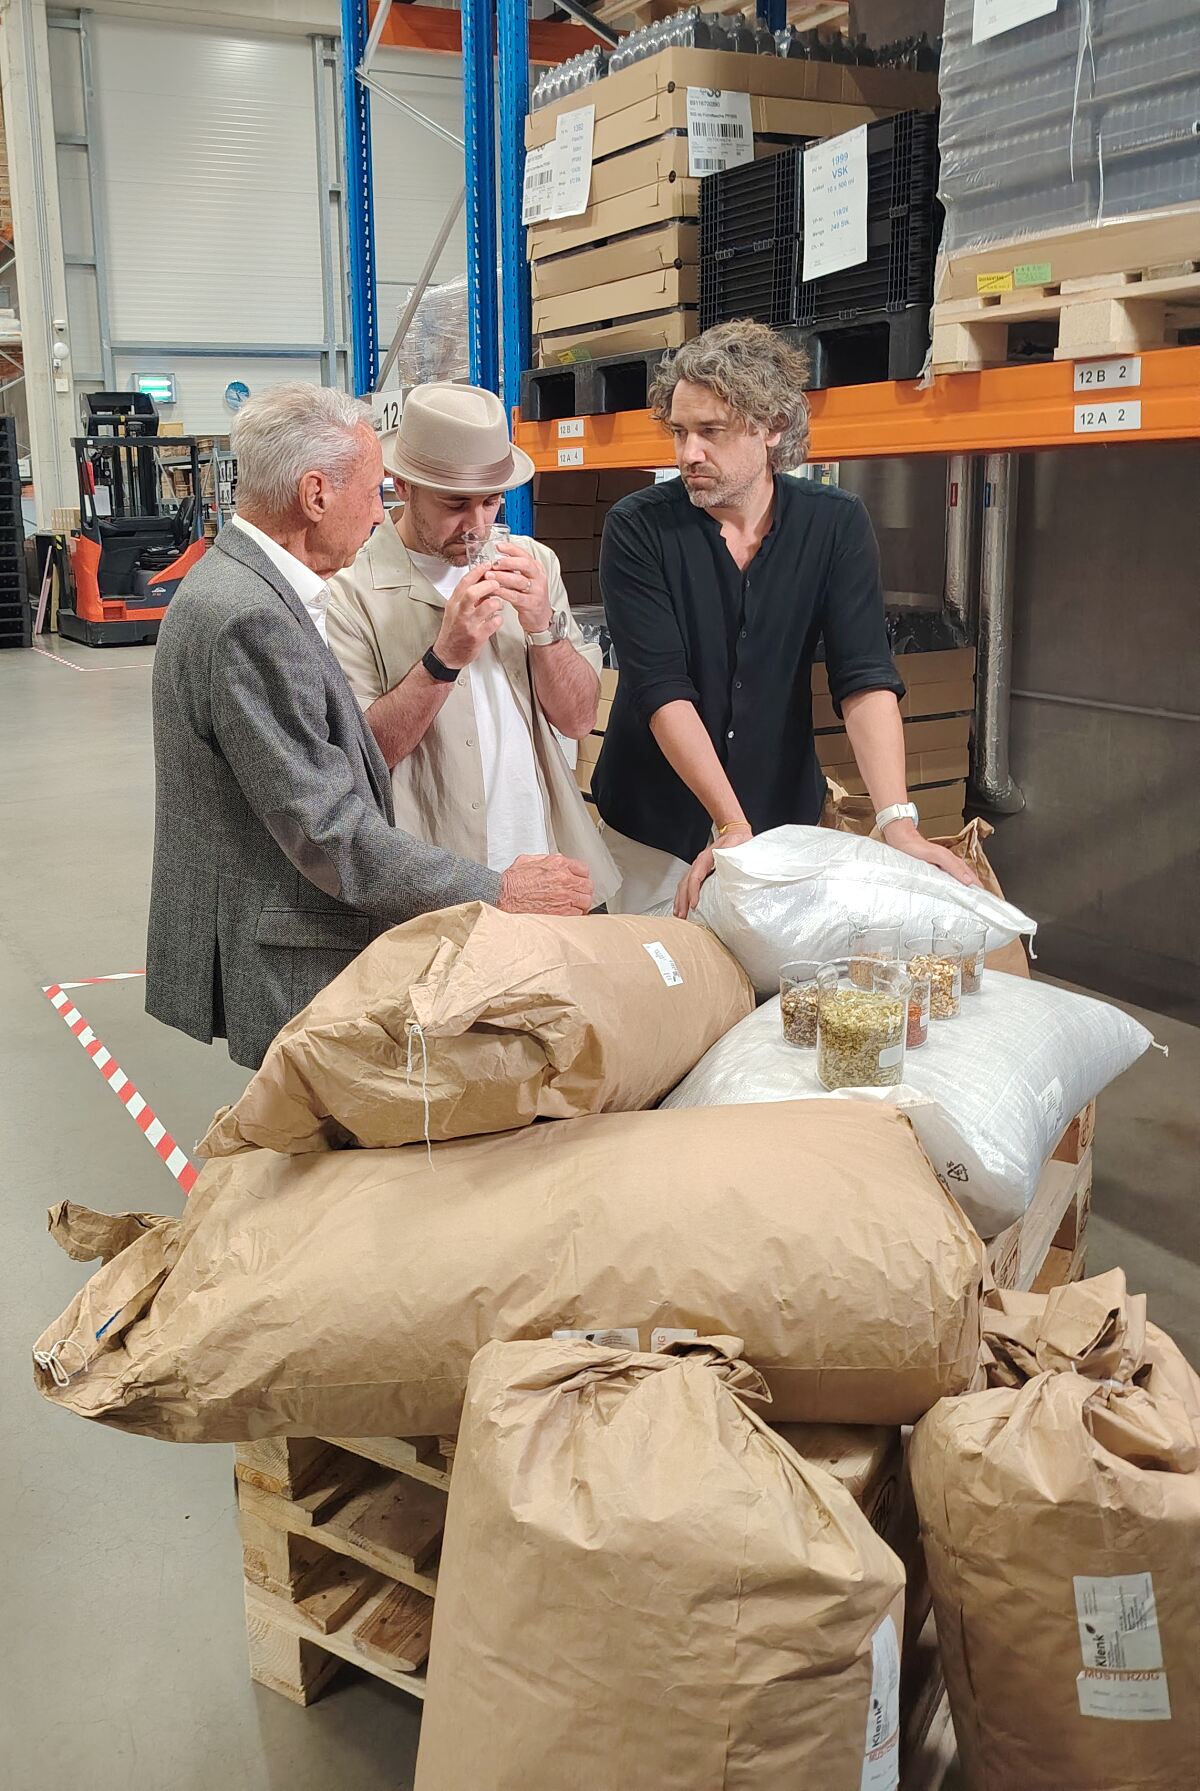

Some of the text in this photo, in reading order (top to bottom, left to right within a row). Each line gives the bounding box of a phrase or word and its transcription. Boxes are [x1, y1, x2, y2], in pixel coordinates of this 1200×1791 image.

[832, 165, 848, 179] VSK
[1079, 365, 1127, 384] 12 B 2
[1080, 408, 1125, 425] 12 A 2
[1093, 1634, 1108, 1668] Klenk
[1084, 1669, 1160, 1682] MUSTERZUG
[871, 1705, 882, 1748] Klenk
